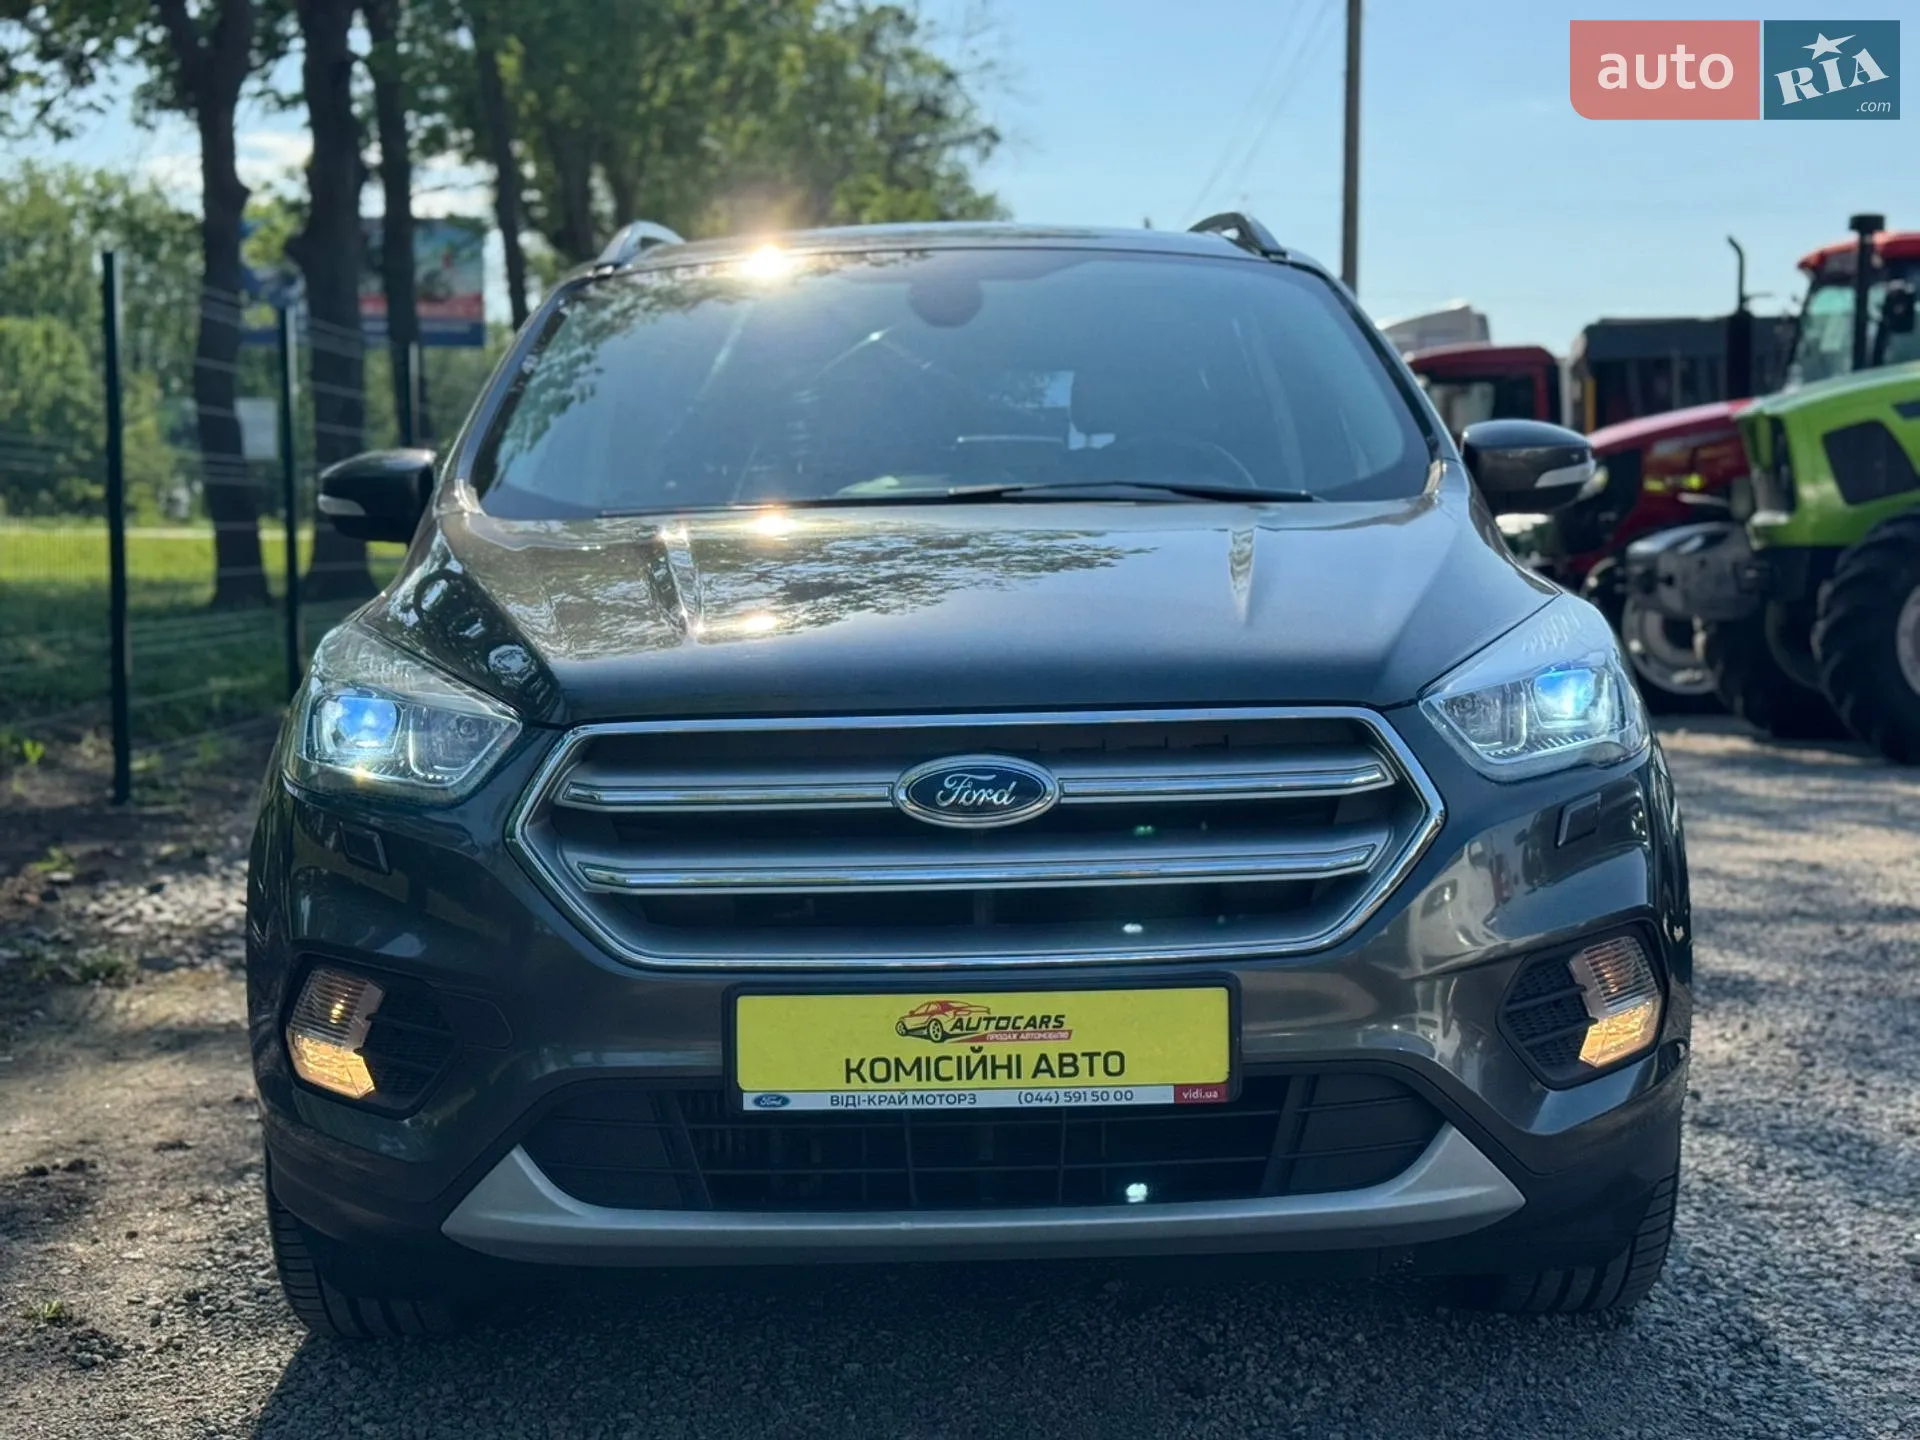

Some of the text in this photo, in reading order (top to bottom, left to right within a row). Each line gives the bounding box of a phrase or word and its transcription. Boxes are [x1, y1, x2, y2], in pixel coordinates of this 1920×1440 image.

[936, 773, 1018, 807] Ford
[951, 1014, 1066, 1032] AUTOCARS
[845, 1046, 1126, 1084] КОМІСІЙНІ АВТО
[830, 1091, 977, 1108] ВІДІ-КРАЙ МОТОРЗ
[1017, 1089, 1134, 1105] (044) 591 50 00
[1182, 1089, 1219, 1100] vidi.ua
